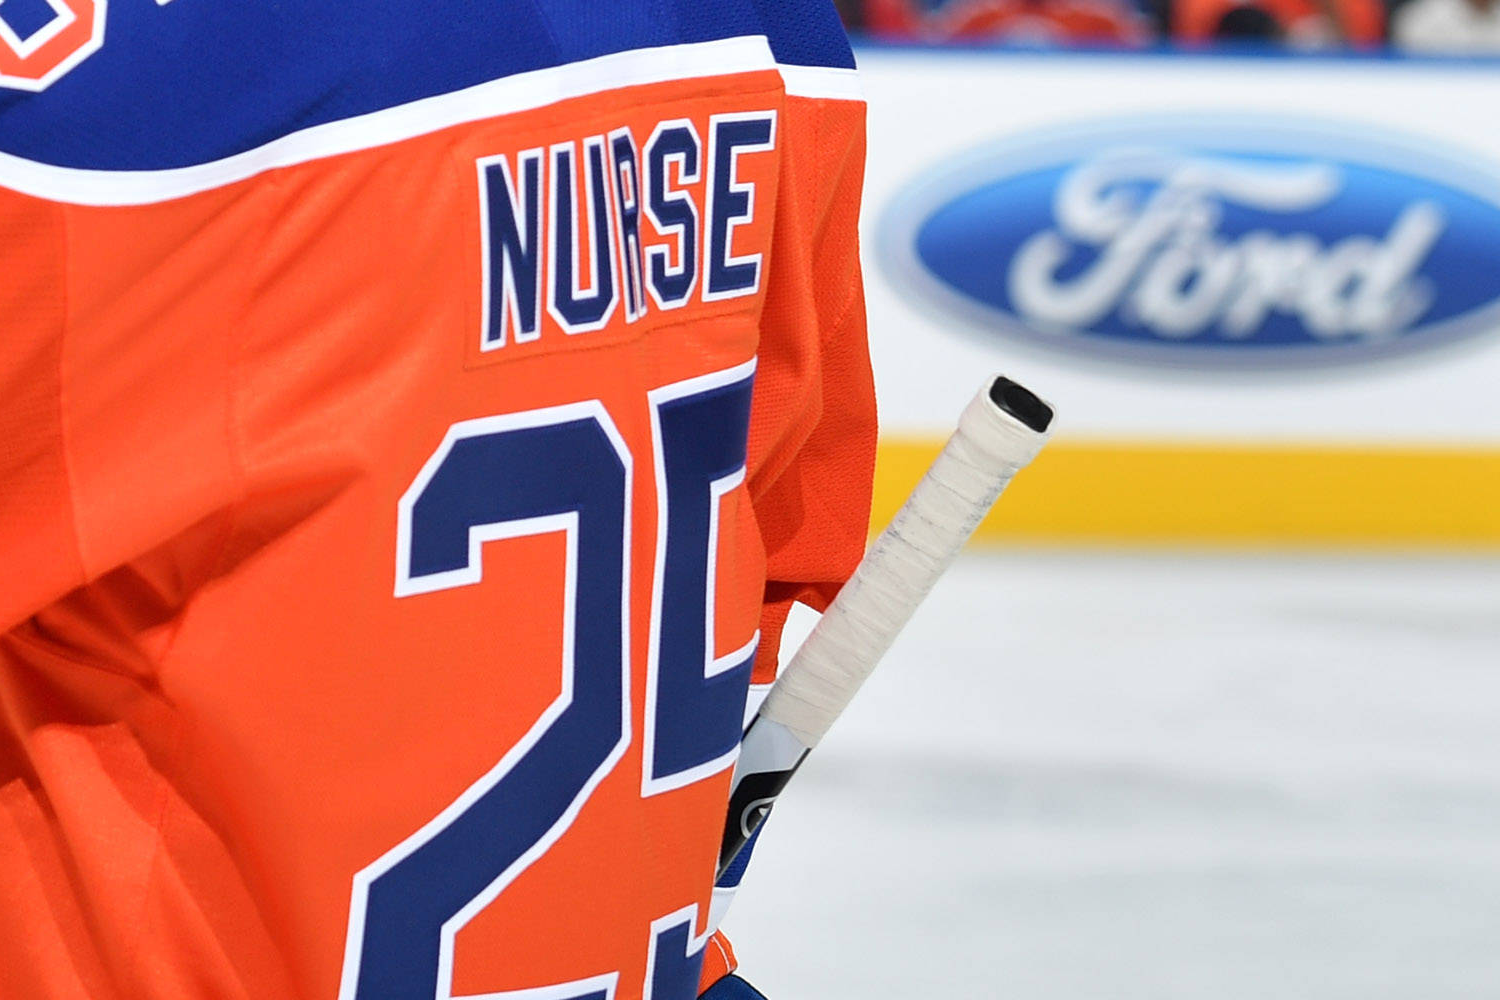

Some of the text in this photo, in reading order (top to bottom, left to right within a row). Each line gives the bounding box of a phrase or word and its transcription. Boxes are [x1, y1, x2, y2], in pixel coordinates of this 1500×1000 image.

[476, 110, 778, 353] NURSE
[1007, 147, 1445, 340] Ford
[338, 355, 760, 1000] 25
